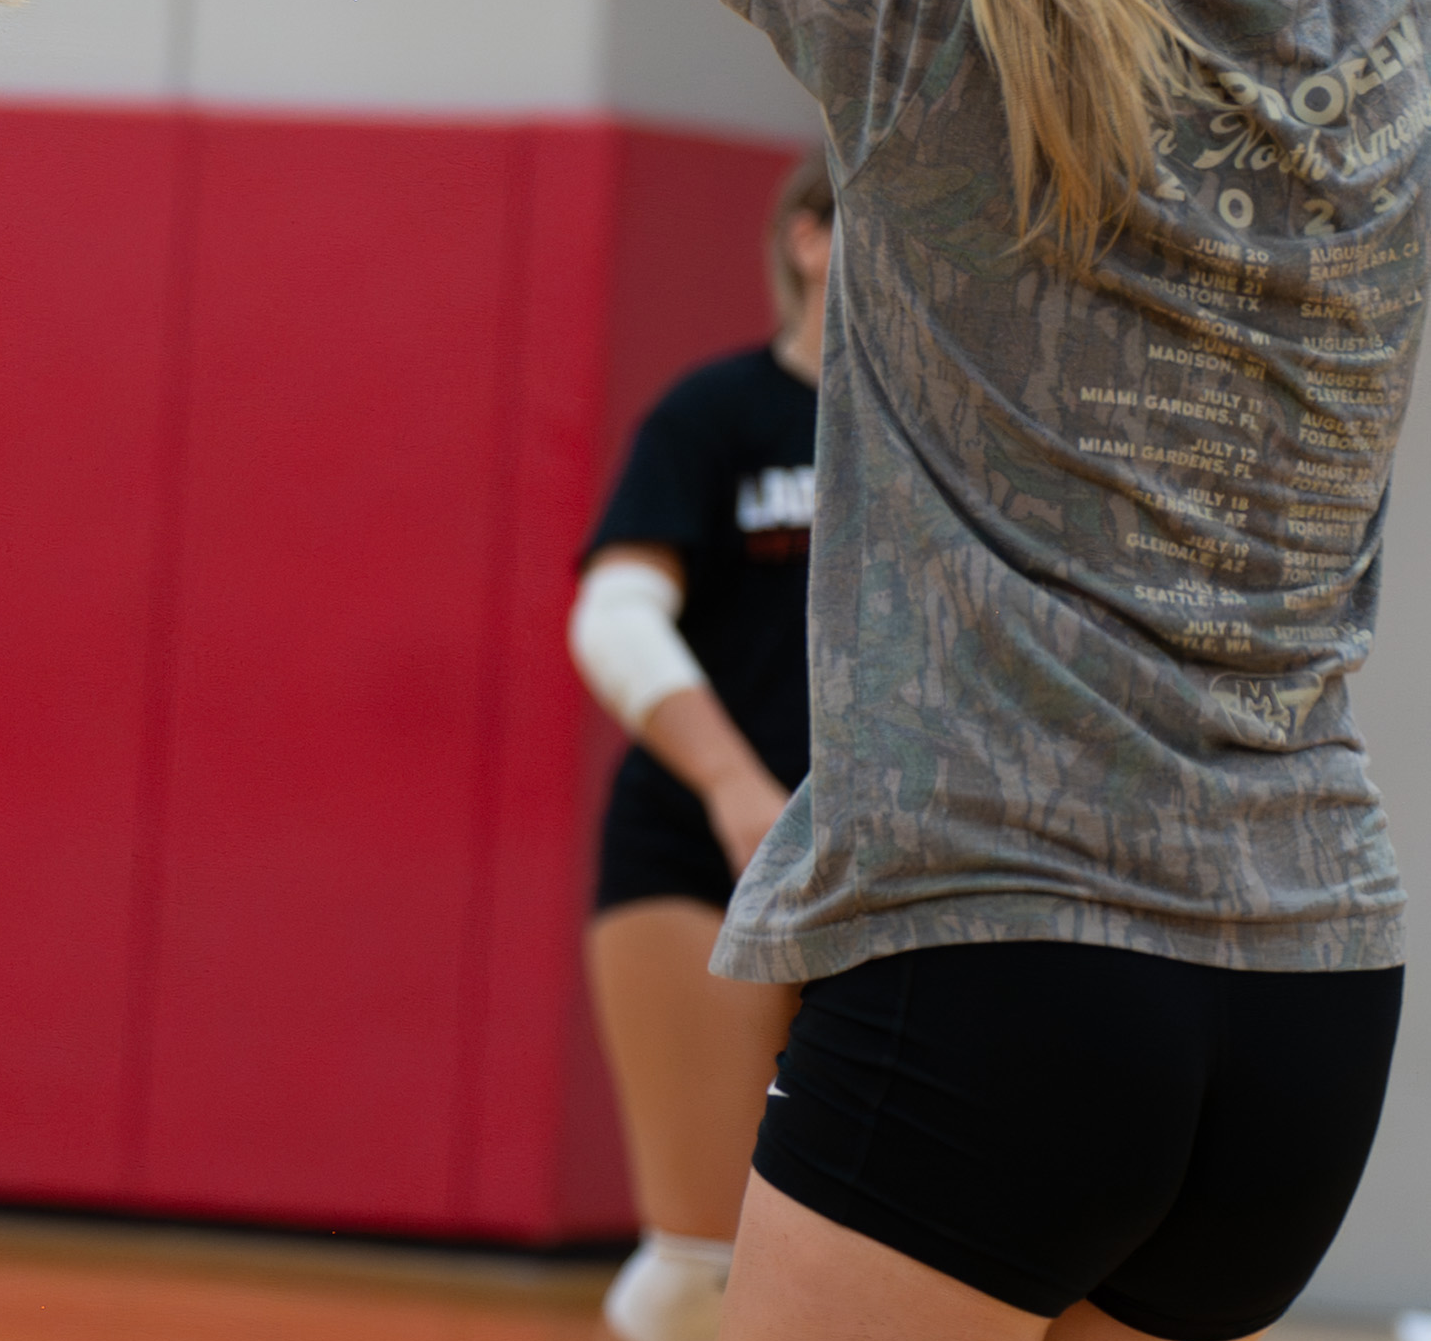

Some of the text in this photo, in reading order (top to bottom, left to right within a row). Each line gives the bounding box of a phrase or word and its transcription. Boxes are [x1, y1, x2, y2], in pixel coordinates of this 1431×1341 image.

[1237, 294, 1261, 313] TX
[1080, 386, 1138, 407] MIAMI
[1239, 412, 1261, 432] FL
[1198, 388, 1242, 409] JULY
[1078, 437, 1136, 458] MIAMI
[1233, 462, 1254, 480] FL
[1190, 437, 1236, 459] JULY
[1184, 488, 1226, 507] JULY
[1183, 619, 1228, 636] JULY
